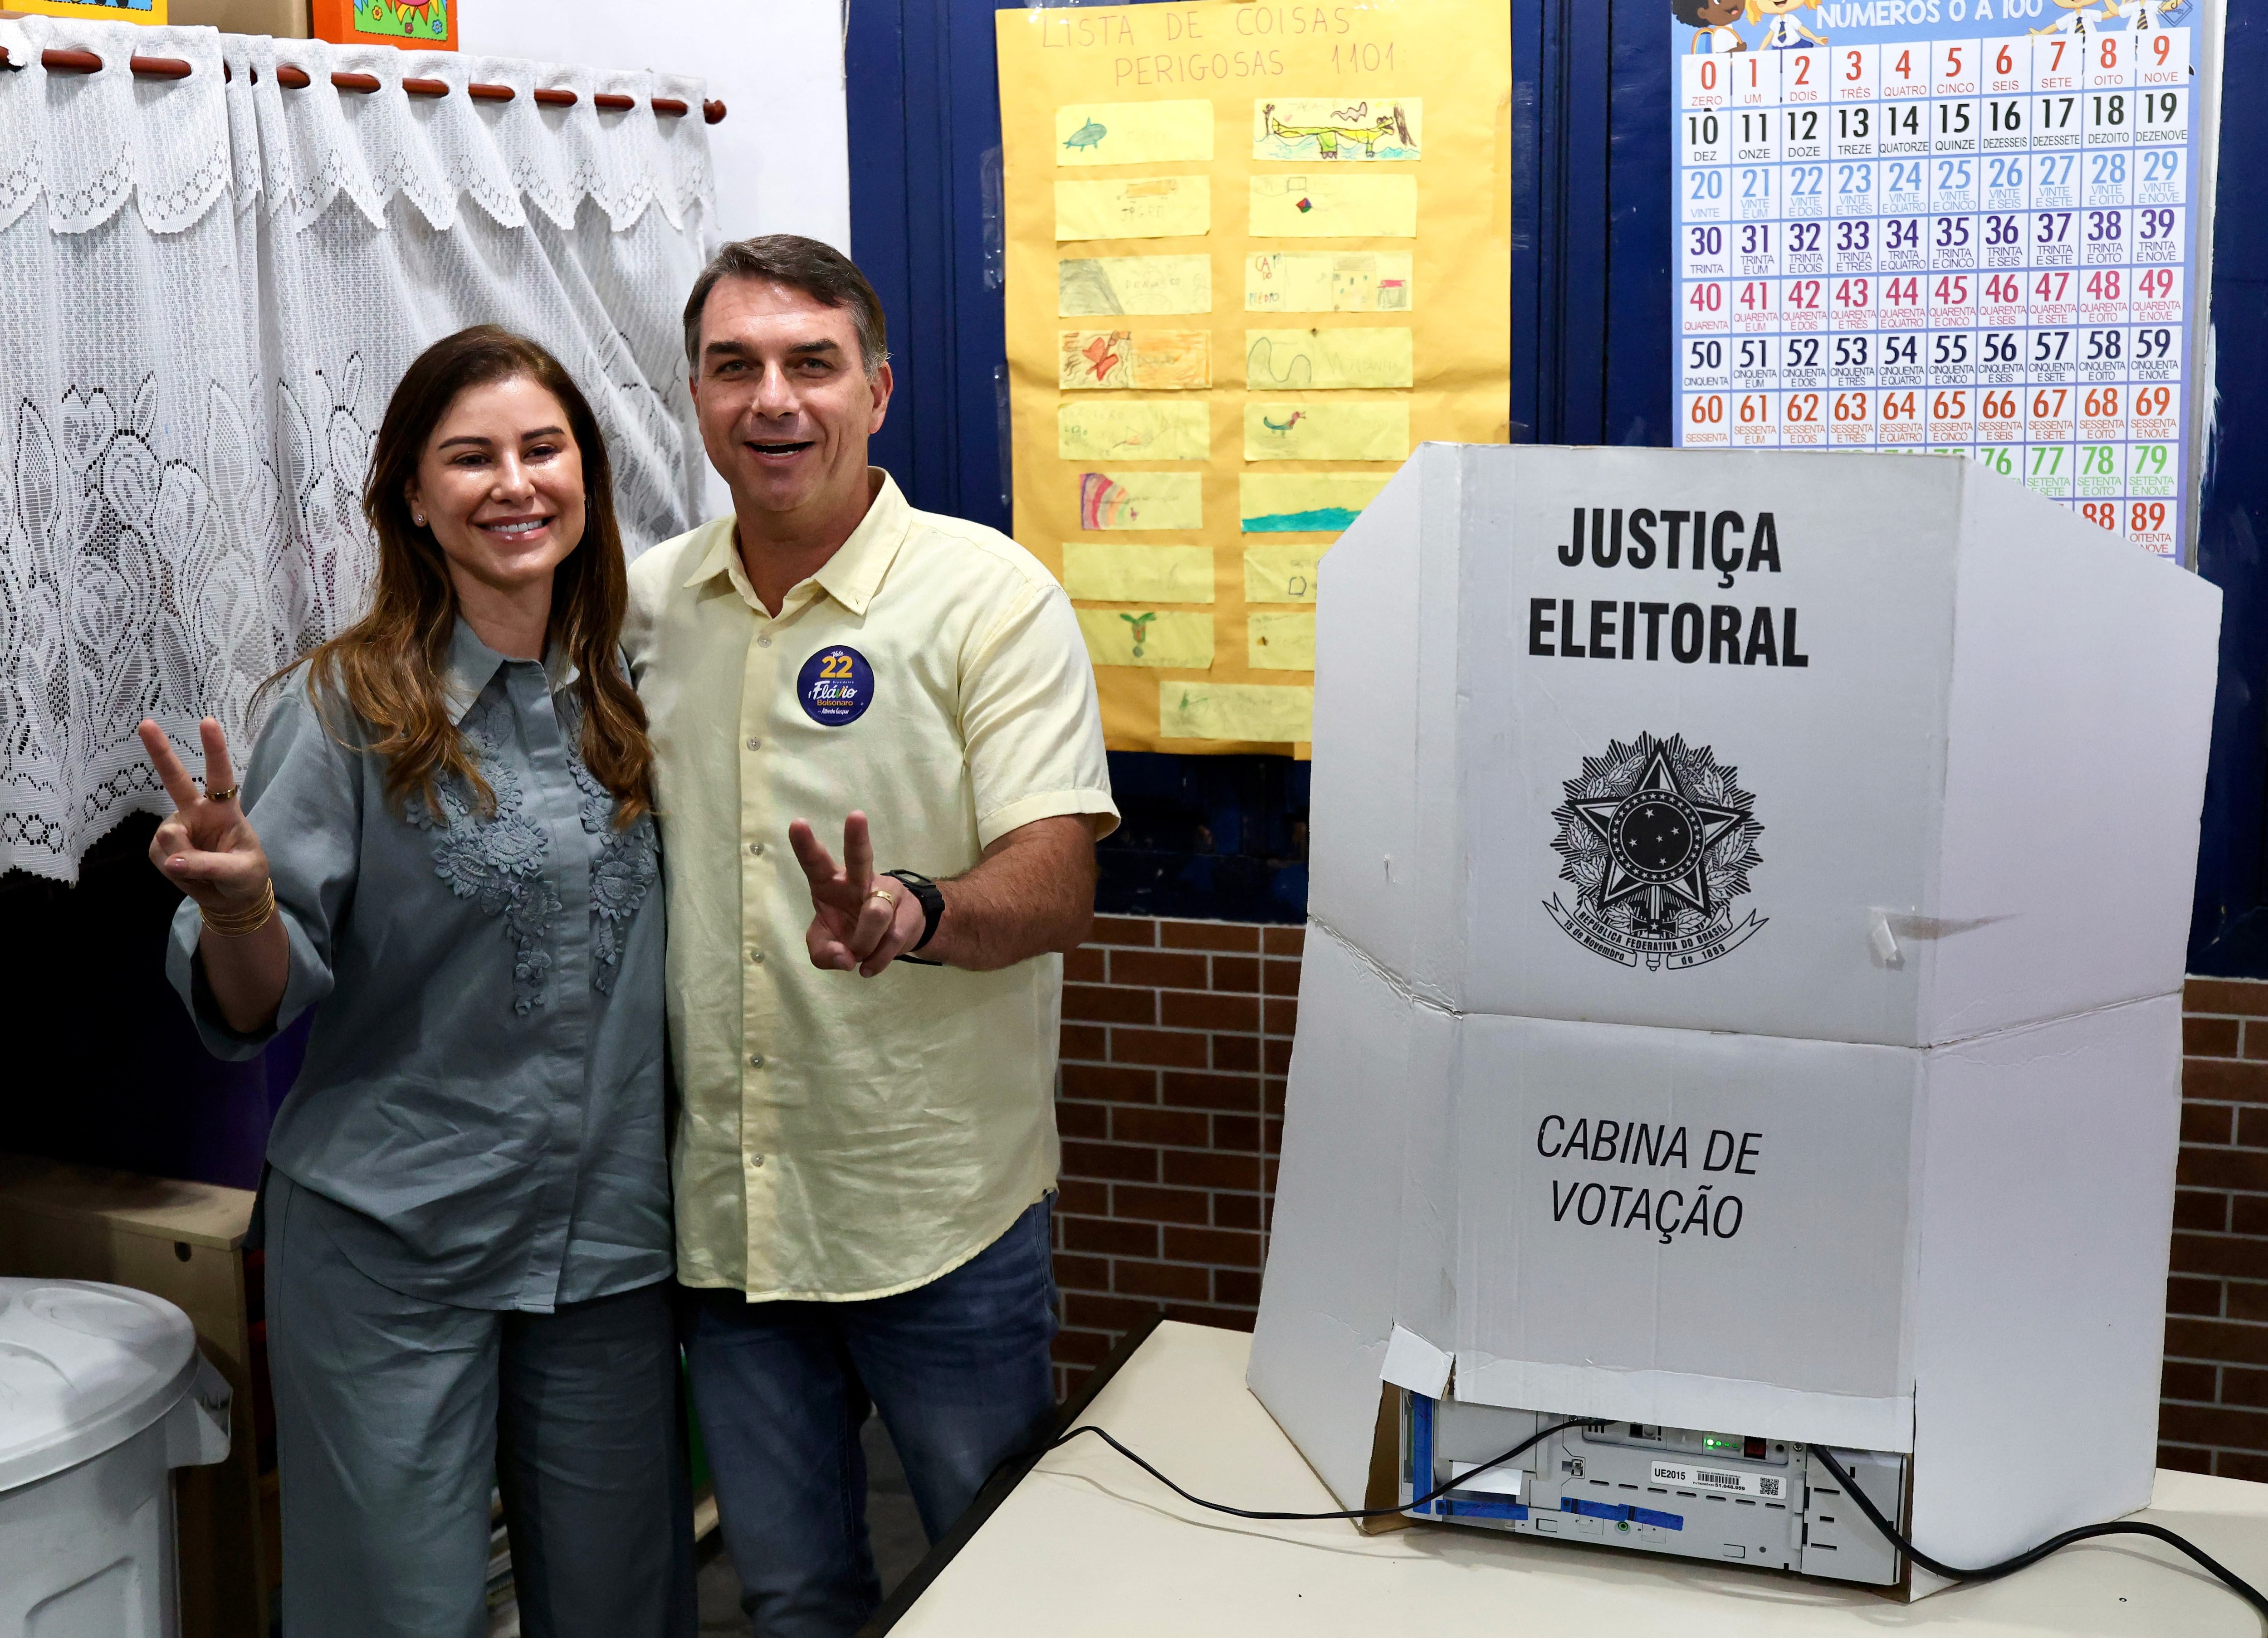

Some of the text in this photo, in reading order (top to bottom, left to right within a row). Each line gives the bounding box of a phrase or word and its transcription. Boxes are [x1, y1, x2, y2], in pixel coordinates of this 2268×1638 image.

[1043, 7, 1349, 47] LISTA DE COISAS
[1817, 0, 1941, 29] NÚMEROS
[1975, 0, 1994, 21] A
[2003, 0, 2042, 19] 100
[1116, 42, 1393, 86] PERIGOSAS 1101
[1896, 50, 1911, 79] 4
[1945, 48, 1961, 77] 5
[1996, 45, 2012, 74] 6
[2051, 41, 2066, 71] 7
[2101, 39, 2116, 68] 8
[2154, 36, 2170, 65] 9
[1701, 61, 1716, 90] 0
[1749, 59, 1756, 87] 1
[1795, 56, 1810, 85] 2
[1846, 51, 1861, 80] 3
[2095, 75, 2122, 85] OITO
[2145, 71, 2178, 83] NOVE
[1790, 91, 1817, 102] DOIS
[1841, 87, 1870, 98] TRÊS
[1885, 85, 1926, 96] QUATRO
[1937, 83, 1974, 93] CINCO
[1993, 81, 2019, 91] SEIS
[2042, 78, 2072, 88] SETE
[1692, 96, 1722, 106] ZERO
[1745, 94, 1761, 103] UM
[2043, 98, 2074, 128] 17
[2093, 95, 2124, 126] 18
[2145, 93, 2177, 123] 19
[1689, 116, 1718, 145] 10
[1742, 114, 1766, 142] 11
[1788, 111, 1817, 140] 12
[1839, 108, 1868, 138] 13
[1888, 106, 1919, 136] 14
[1940, 103, 1970, 133] 15
[1990, 101, 2021, 131] 16
[1838, 144, 1871, 155] TREZE
[1880, 141, 1928, 153] QUATORZE
[1936, 140, 1975, 151] QUINZE
[1984, 137, 2027, 148] DEZESSEIS
[2033, 135, 2079, 146] DEZESSETE
[2089, 132, 2129, 144] DEZOITO
[2136, 130, 2186, 141] DEZENOVE
[1695, 151, 1716, 161] DEZ
[1739, 149, 1770, 159] ONZE
[1789, 146, 1820, 157] DOZE
[2143, 151, 2178, 181] 29
[1742, 169, 1769, 198] 21
[1791, 166, 1823, 196] 22
[1839, 164, 1871, 194] 23
[1889, 162, 1921, 192] 24
[1938, 160, 1971, 190] 25
[1989, 158, 2023, 188] 26
[2039, 156, 2075, 185] 27
[2092, 154, 2126, 184] 28
[1691, 171, 1722, 200] 20
[2139, 192, 2179, 203] E NOVE
[2144, 182, 2175, 192] VINTE
[1691, 208, 1719, 217] VINTE
[2088, 211, 2121, 241] 38
[2140, 209, 2174, 239] 39
[1691, 227, 1721, 255] 30
[1742, 225, 1768, 253] 31
[1789, 223, 1821, 252] 32
[1837, 221, 1869, 250] 33
[1886, 219, 1919, 249] 34
[1936, 217, 1969, 246] 35
[1985, 215, 2019, 245] 36
[2038, 213, 2072, 243] 37
[1690, 264, 1724, 273] TRINTA
[1690, 283, 1721, 312] 40
[1740, 282, 1767, 310] 41
[1789, 280, 1820, 309] 42
[1836, 278, 1868, 307] 43
[1886, 277, 1918, 306] 44
[1935, 276, 1967, 305] 45
[1985, 274, 2019, 303] 46
[2035, 273, 2070, 302] 47
[2087, 271, 2120, 300] 48
[2139, 269, 2173, 298] 49
[1685, 321, 1728, 330] QUARENTA
[1690, 341, 1721, 369] 50
[1740, 340, 1766, 368] 51
[1787, 339, 1819, 367] 52
[1835, 337, 1867, 366] 53
[1884, 336, 1917, 365] 54
[1934, 335, 1967, 364] 55
[1984, 333, 2017, 362] 56
[2035, 332, 2069, 361] 57
[2087, 330, 2121, 360] 58
[2136, 329, 2170, 359] 59
[2131, 360, 2178, 371] CINQUENTA
[2139, 370, 2169, 380] E NOVE
[1692, 395, 1723, 423] 60
[1740, 395, 1766, 423] 61
[1788, 394, 1818, 422] 62
[1834, 393, 1866, 421] 63
[1883, 392, 1916, 420] 64
[1934, 391, 1965, 419] 65
[1983, 390, 2015, 419] 66
[2033, 389, 2067, 418] 67
[2085, 388, 2118, 417] 68
[2136, 387, 2170, 416] 69
[1686, 434, 1727, 442] SESSENTA
[2032, 447, 2064, 475] 77
[2083, 446, 2113, 475] 78
[2136, 445, 2167, 474] 79
[2077, 477, 2122, 486] SETENTA
[2083, 487, 2115, 496] E OITO
[2129, 476, 2174, 486] SETENTA
[2133, 486, 2170, 495] E NOVE
[2131, 502, 2165, 531] 89
[1558, 508, 1781, 589] JUSTIÇA
[2130, 533, 2172, 542] OITENTA
[1529, 598, 1809, 667] ELEITORAL
[820, 656, 853, 678] 22
[813, 680, 858, 700] Flávio
[1564, 920, 1725, 965] 15 de Novembro de 1889
[1579, 911, 1727, 951] REPÚBLICA FEDERATIVA DO BRASIL
[1537, 1115, 1763, 1175] CABINA DE
[1553, 1180, 1743, 1244] VOTAÇÃO
[1655, 1468, 1686, 1480] UE2015
[1715, 1483, 1745, 1491] 51.048.959
